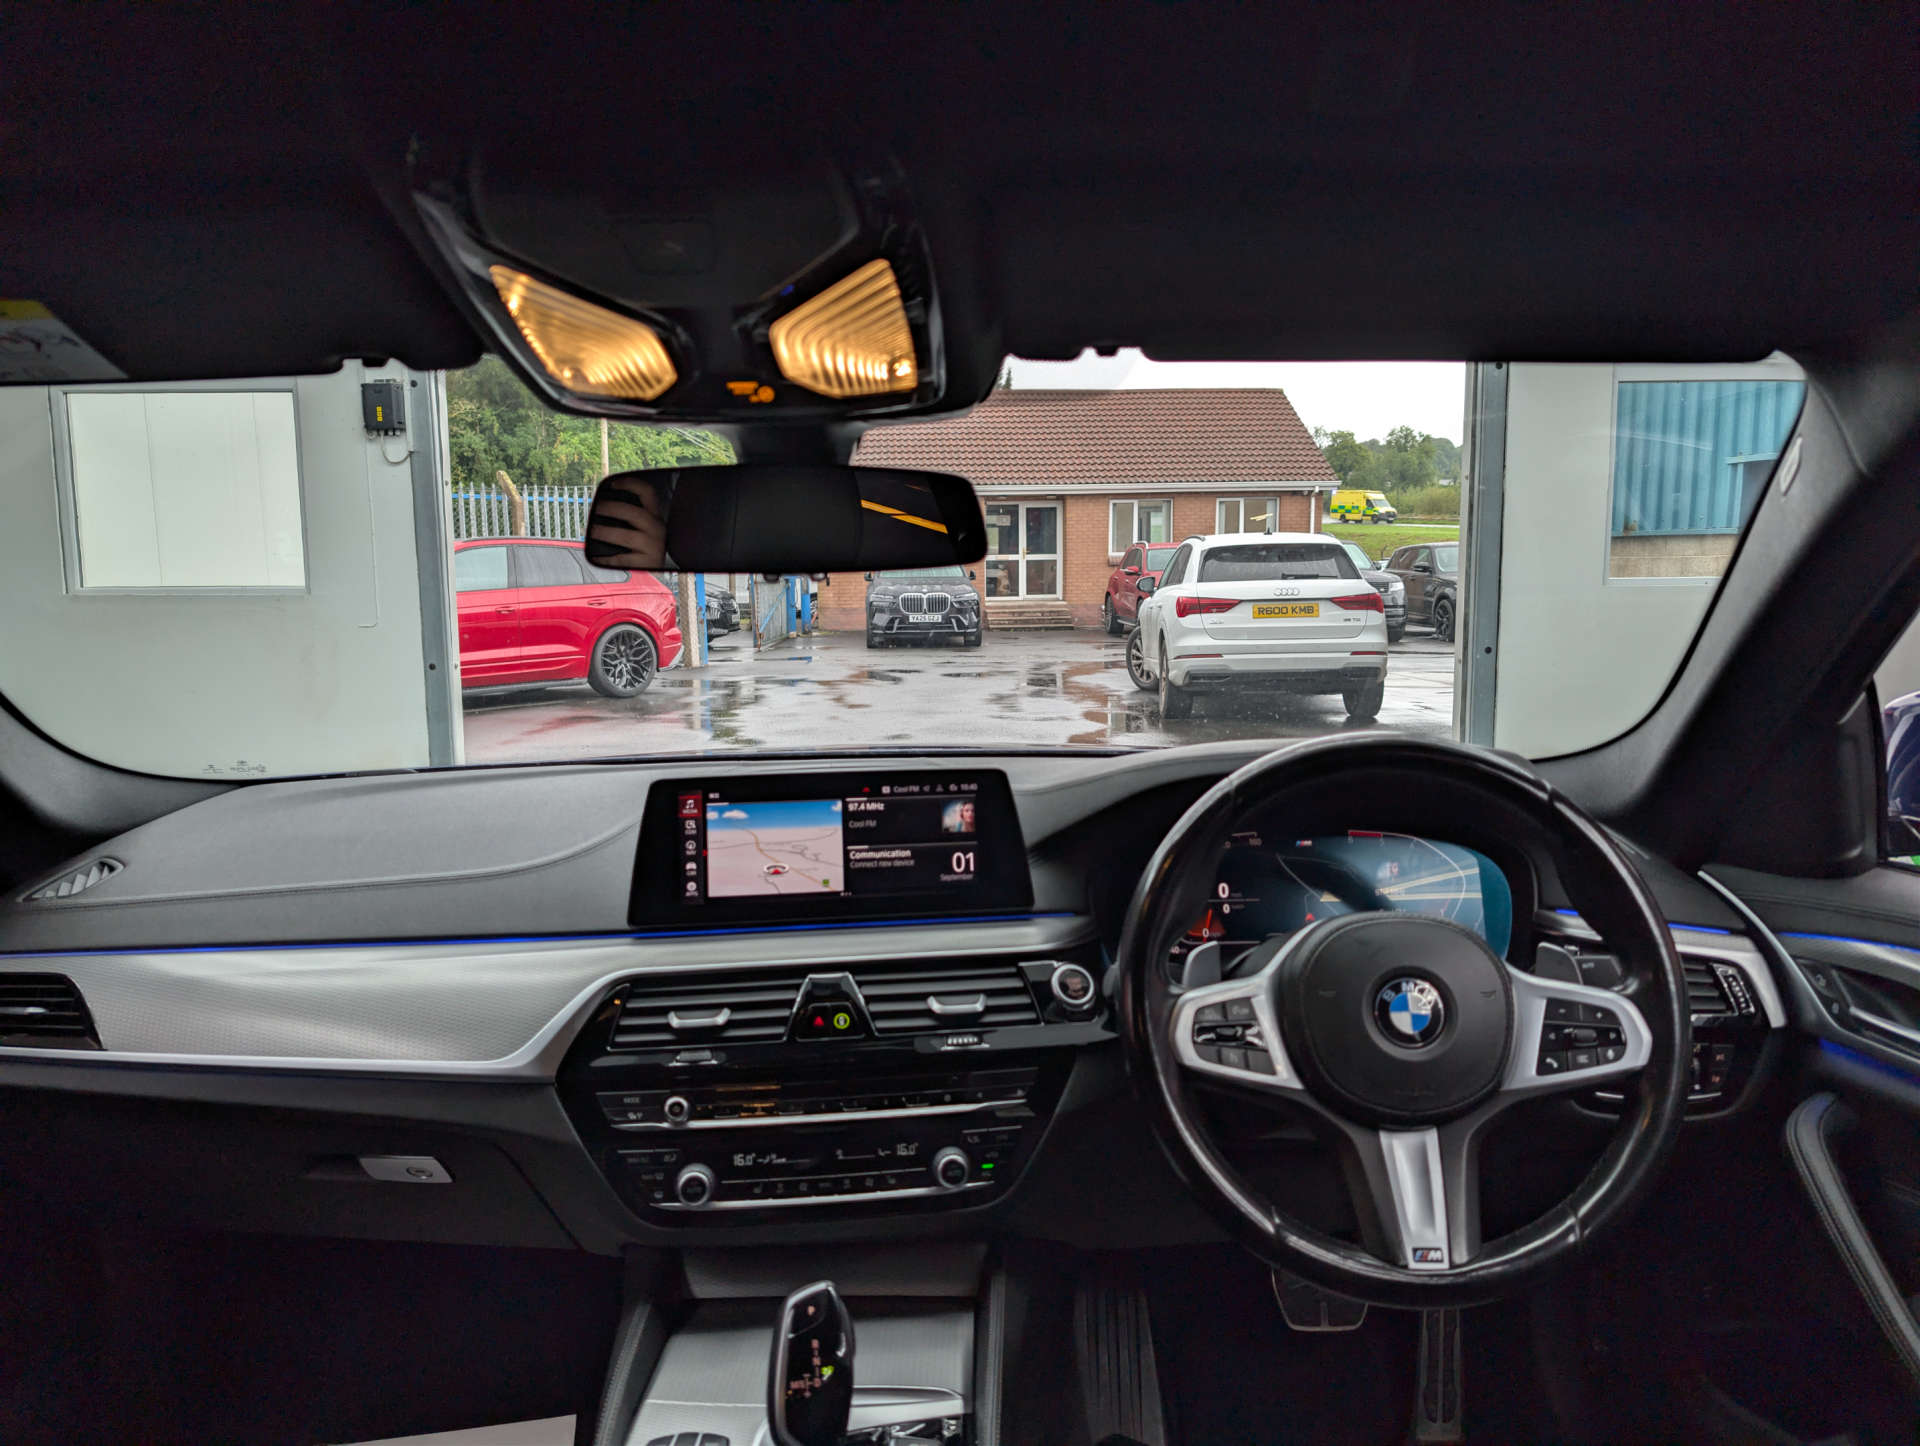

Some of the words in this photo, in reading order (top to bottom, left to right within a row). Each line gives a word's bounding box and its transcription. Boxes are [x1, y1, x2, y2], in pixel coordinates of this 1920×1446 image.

[1257, 606, 1289, 616] R600
[1291, 606, 1314, 615] KMB
[866, 802, 885, 811] MHz
[849, 820, 865, 828] Cool
[865, 819, 877, 828] FM
[850, 849, 911, 860] Communication
[850, 860, 878, 868] Connect
[893, 858, 915, 867] device
[952, 851, 975, 873] 01
[940, 873, 974, 882] September
[1218, 882, 1229, 898] 0
